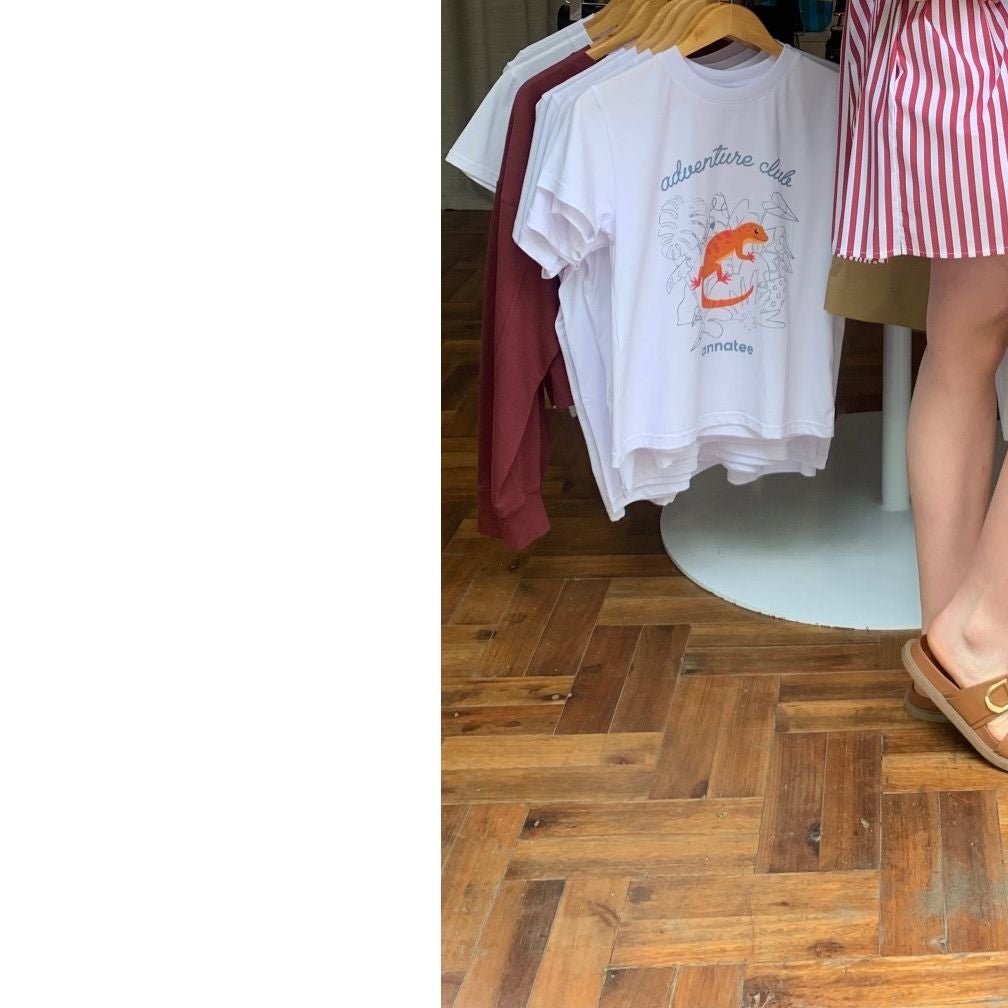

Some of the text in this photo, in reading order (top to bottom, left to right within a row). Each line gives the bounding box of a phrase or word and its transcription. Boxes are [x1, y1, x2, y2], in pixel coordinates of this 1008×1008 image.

[661, 144, 796, 192] adventure club
[701, 340, 754, 357] annatee
